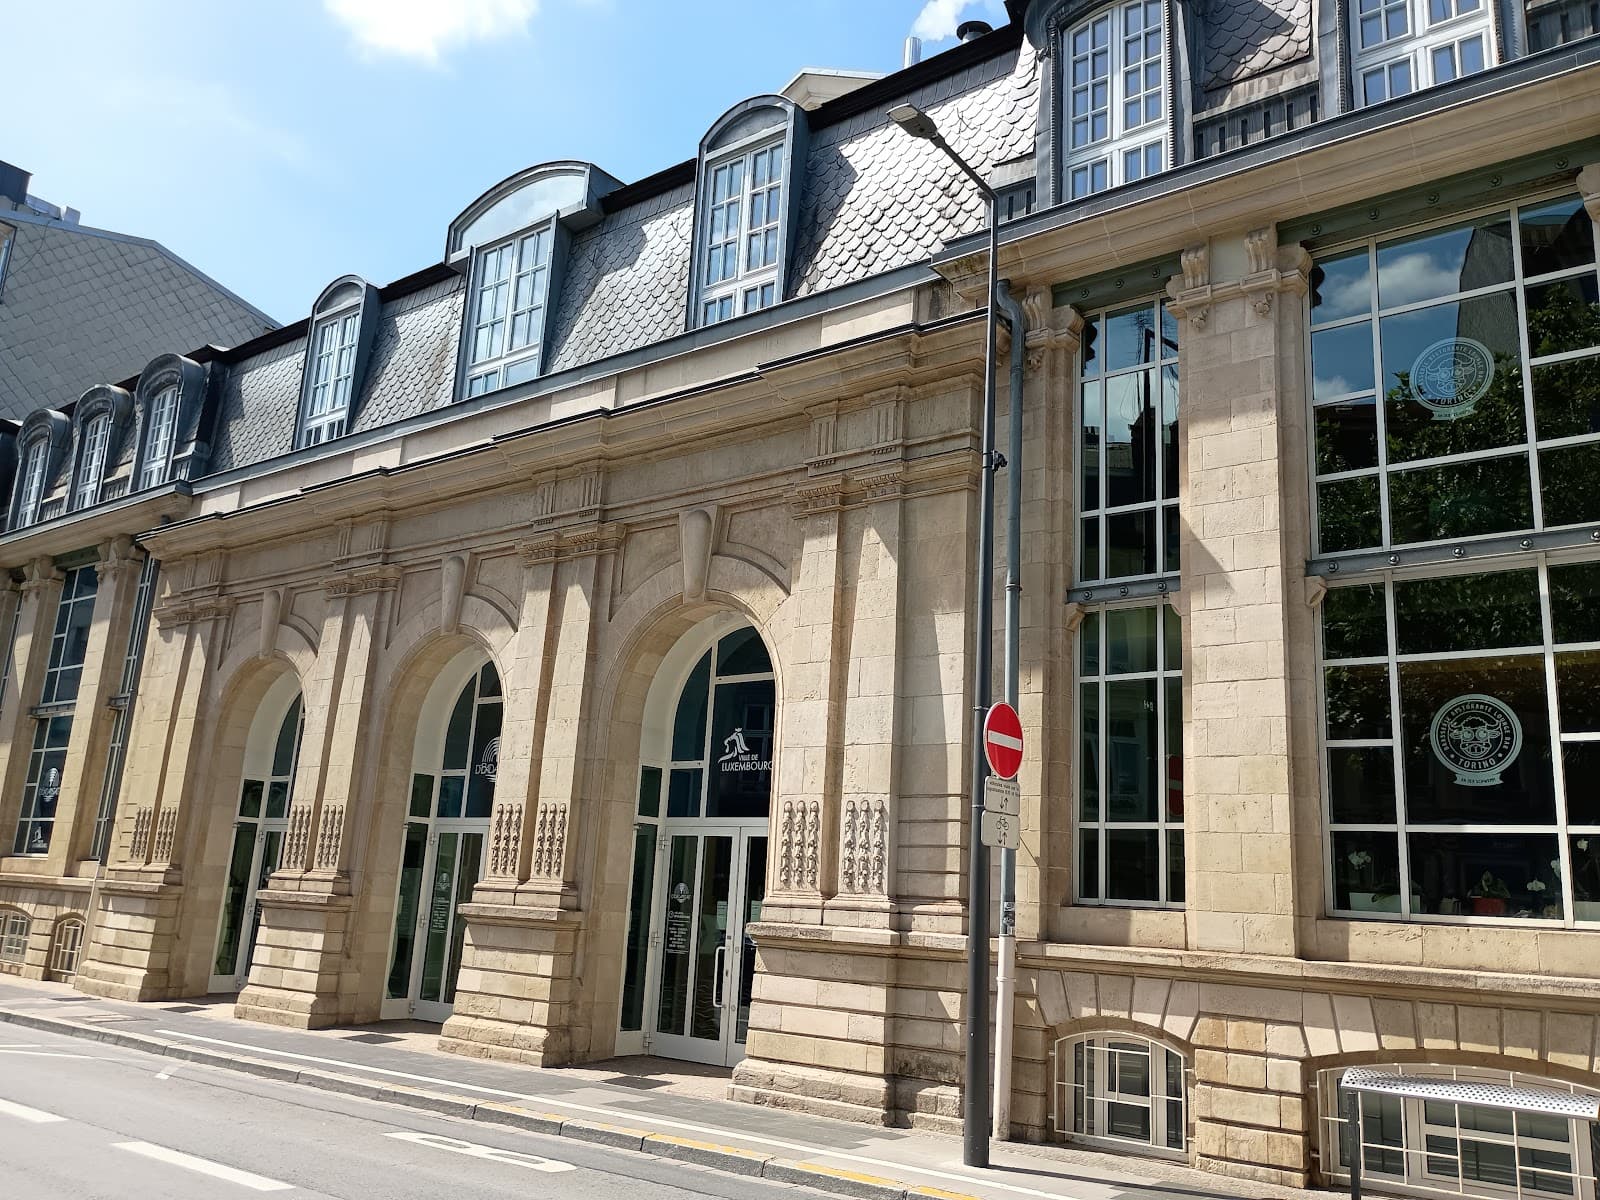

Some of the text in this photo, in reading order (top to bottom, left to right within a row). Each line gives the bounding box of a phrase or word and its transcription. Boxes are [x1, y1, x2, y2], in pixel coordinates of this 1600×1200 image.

[1450, 702, 1493, 716] RISTORANTE
[1494, 711, 1512, 734] LOUNGE
[1458, 757, 1496, 770] TORINO
